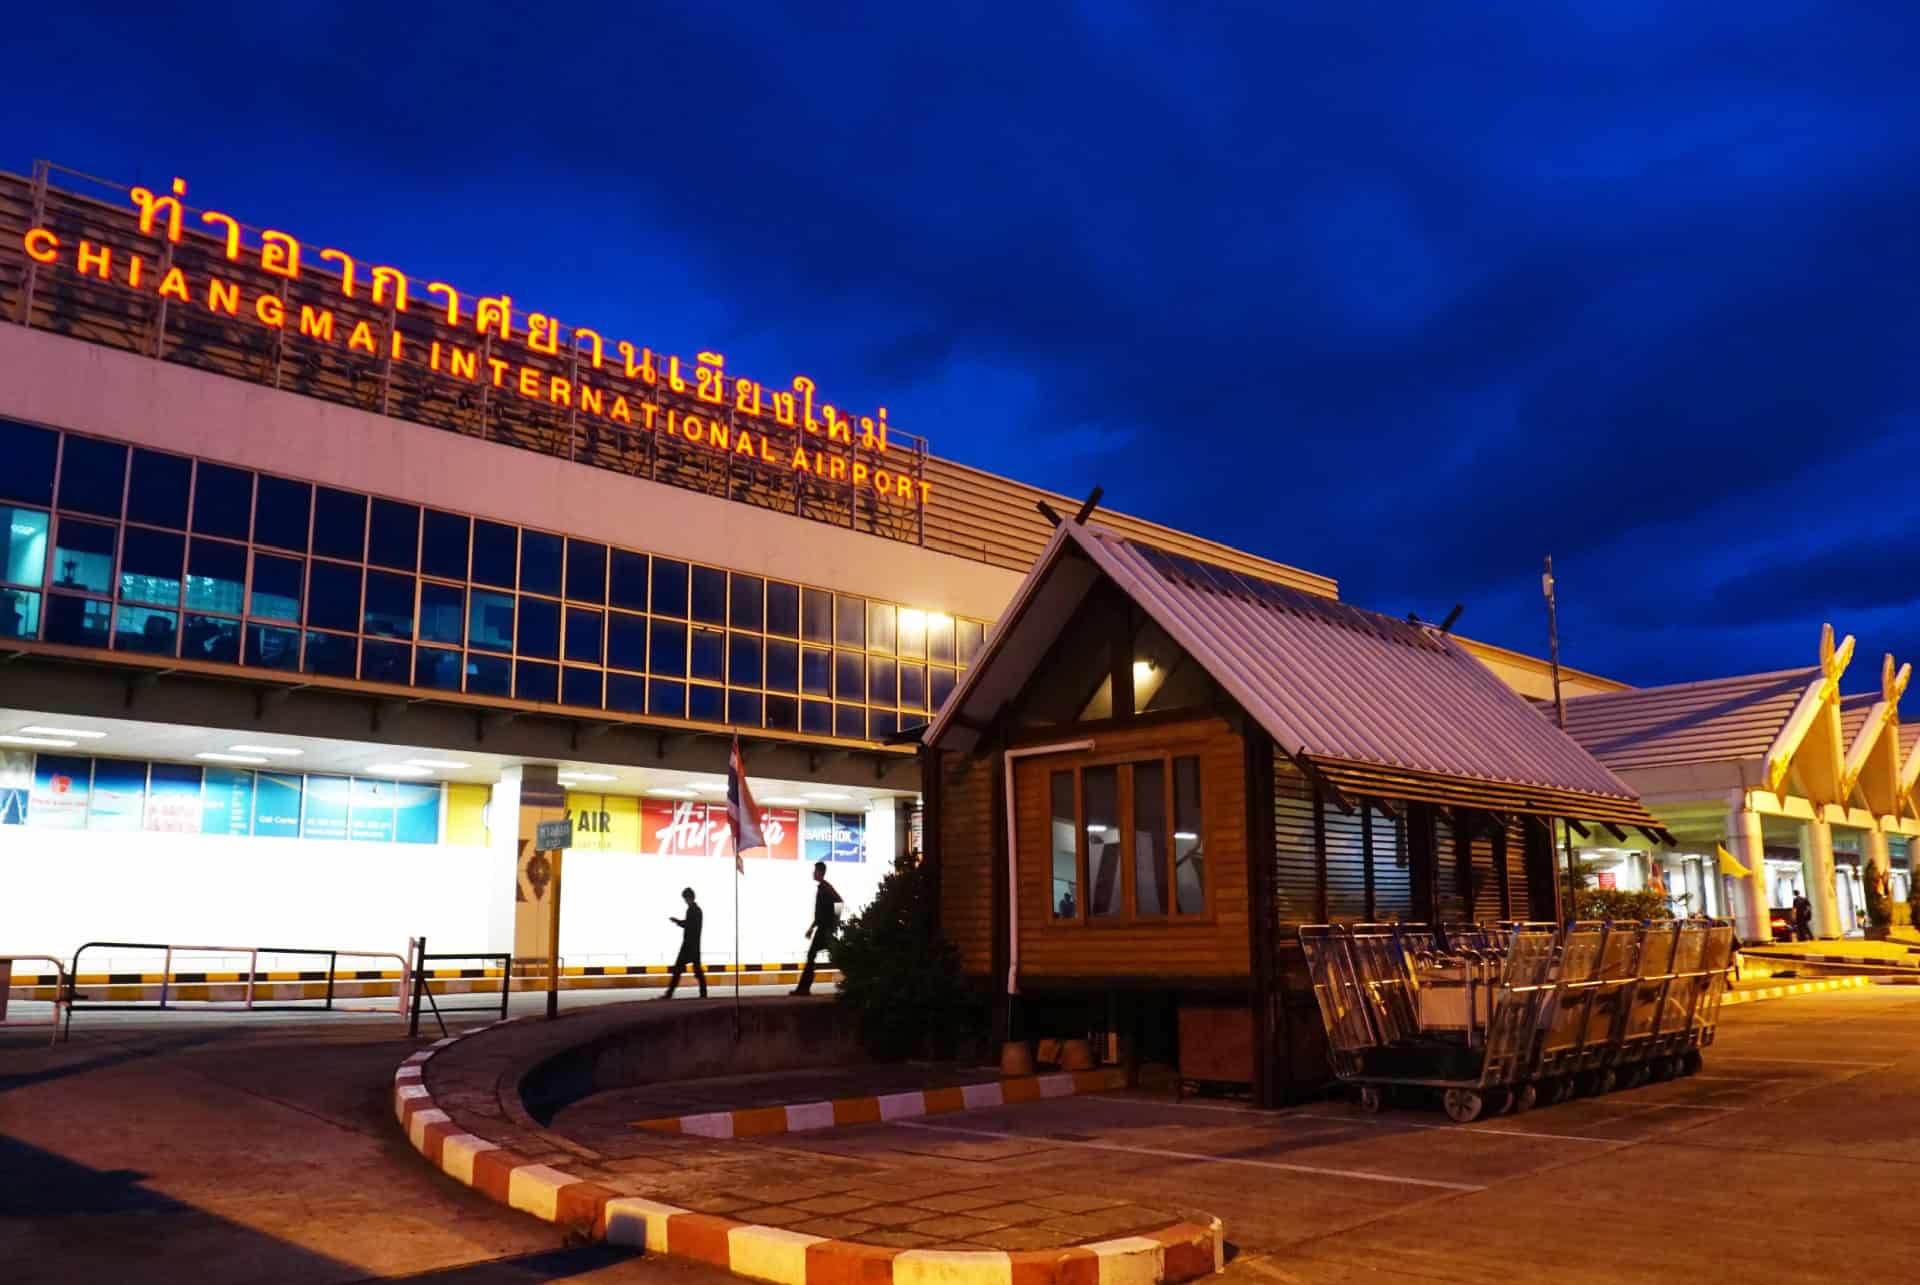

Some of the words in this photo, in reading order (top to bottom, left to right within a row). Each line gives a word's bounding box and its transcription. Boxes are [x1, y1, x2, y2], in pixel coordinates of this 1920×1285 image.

[24, 227, 403, 360] CHIANGMAI
[430, 342, 777, 464] INTERNATIONAL
[791, 446, 934, 506] AIRPORT
[577, 809, 611, 832] AIR
